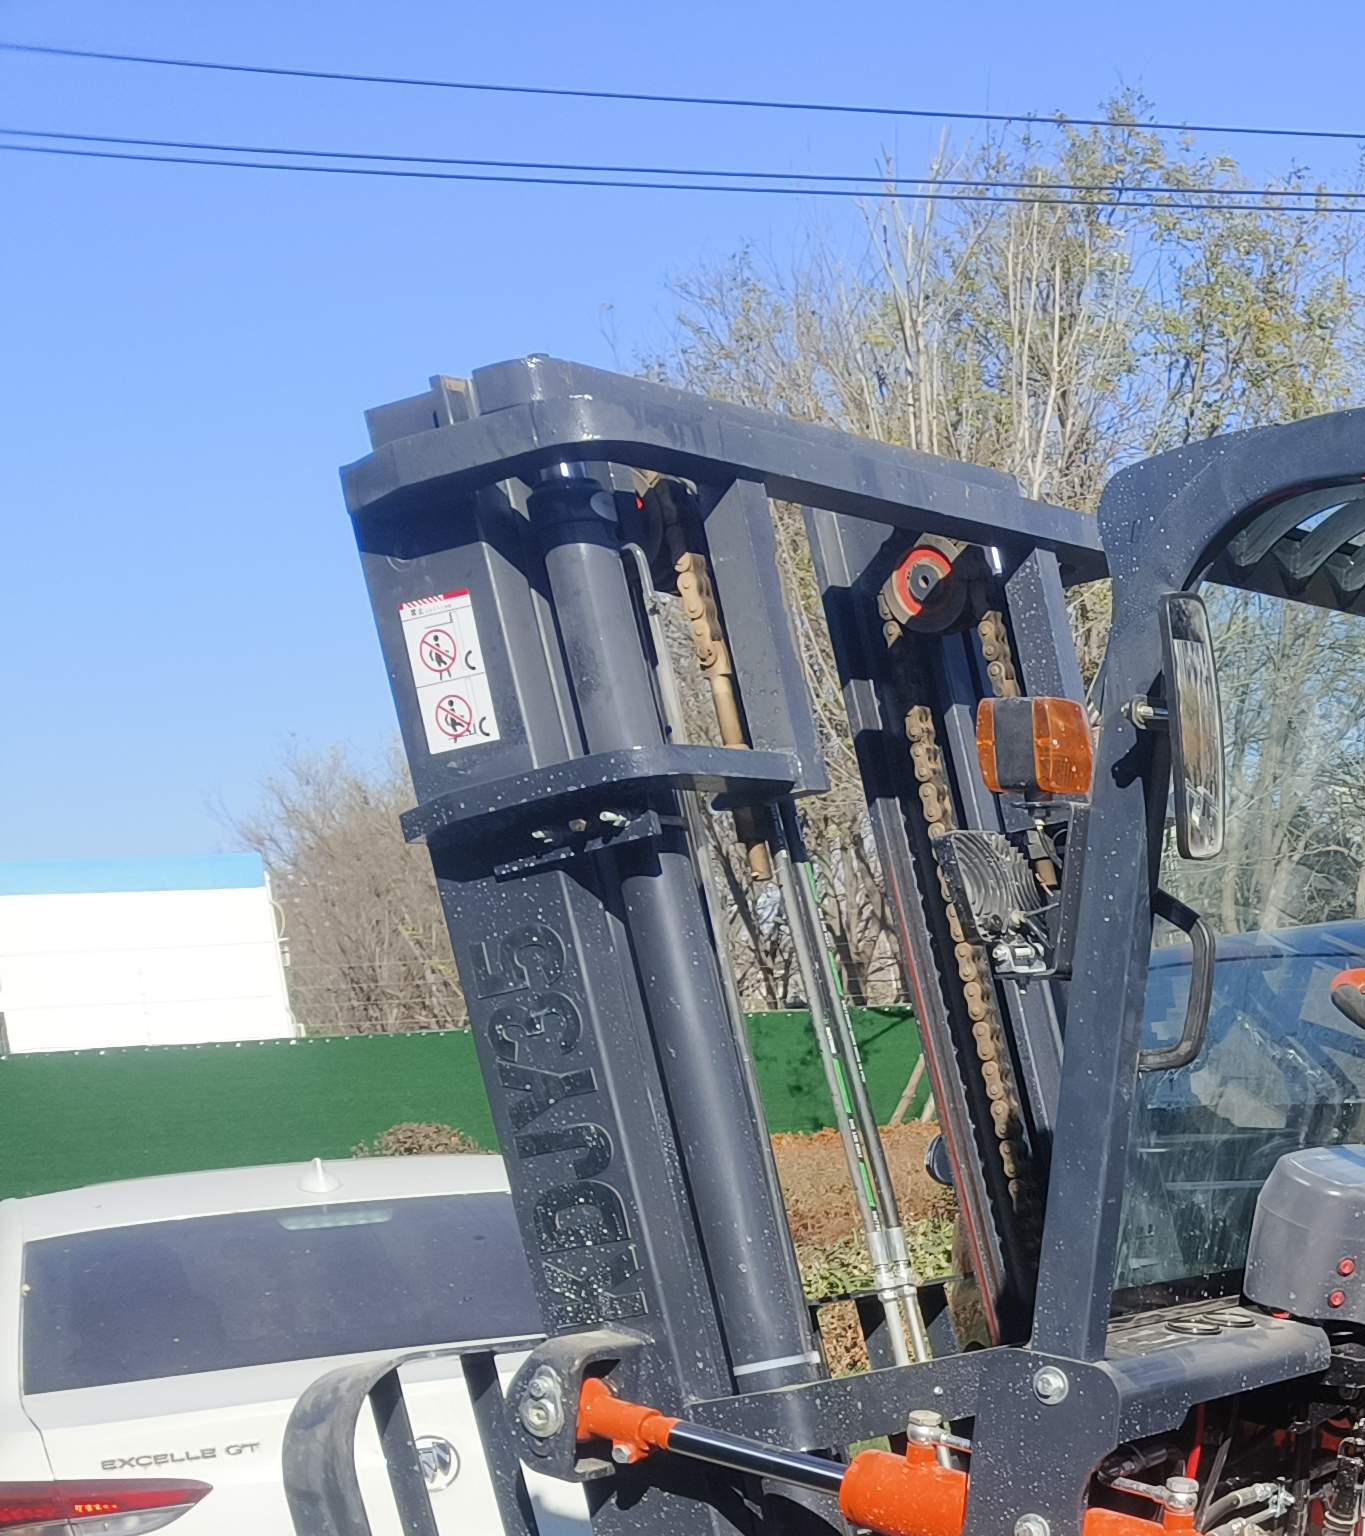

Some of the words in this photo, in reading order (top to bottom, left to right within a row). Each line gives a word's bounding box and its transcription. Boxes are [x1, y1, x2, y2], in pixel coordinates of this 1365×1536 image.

[469, 923, 649, 1328] KDJY35
[101, 1448, 217, 1471] EXCELLE
[225, 1442, 260, 1456] GT
